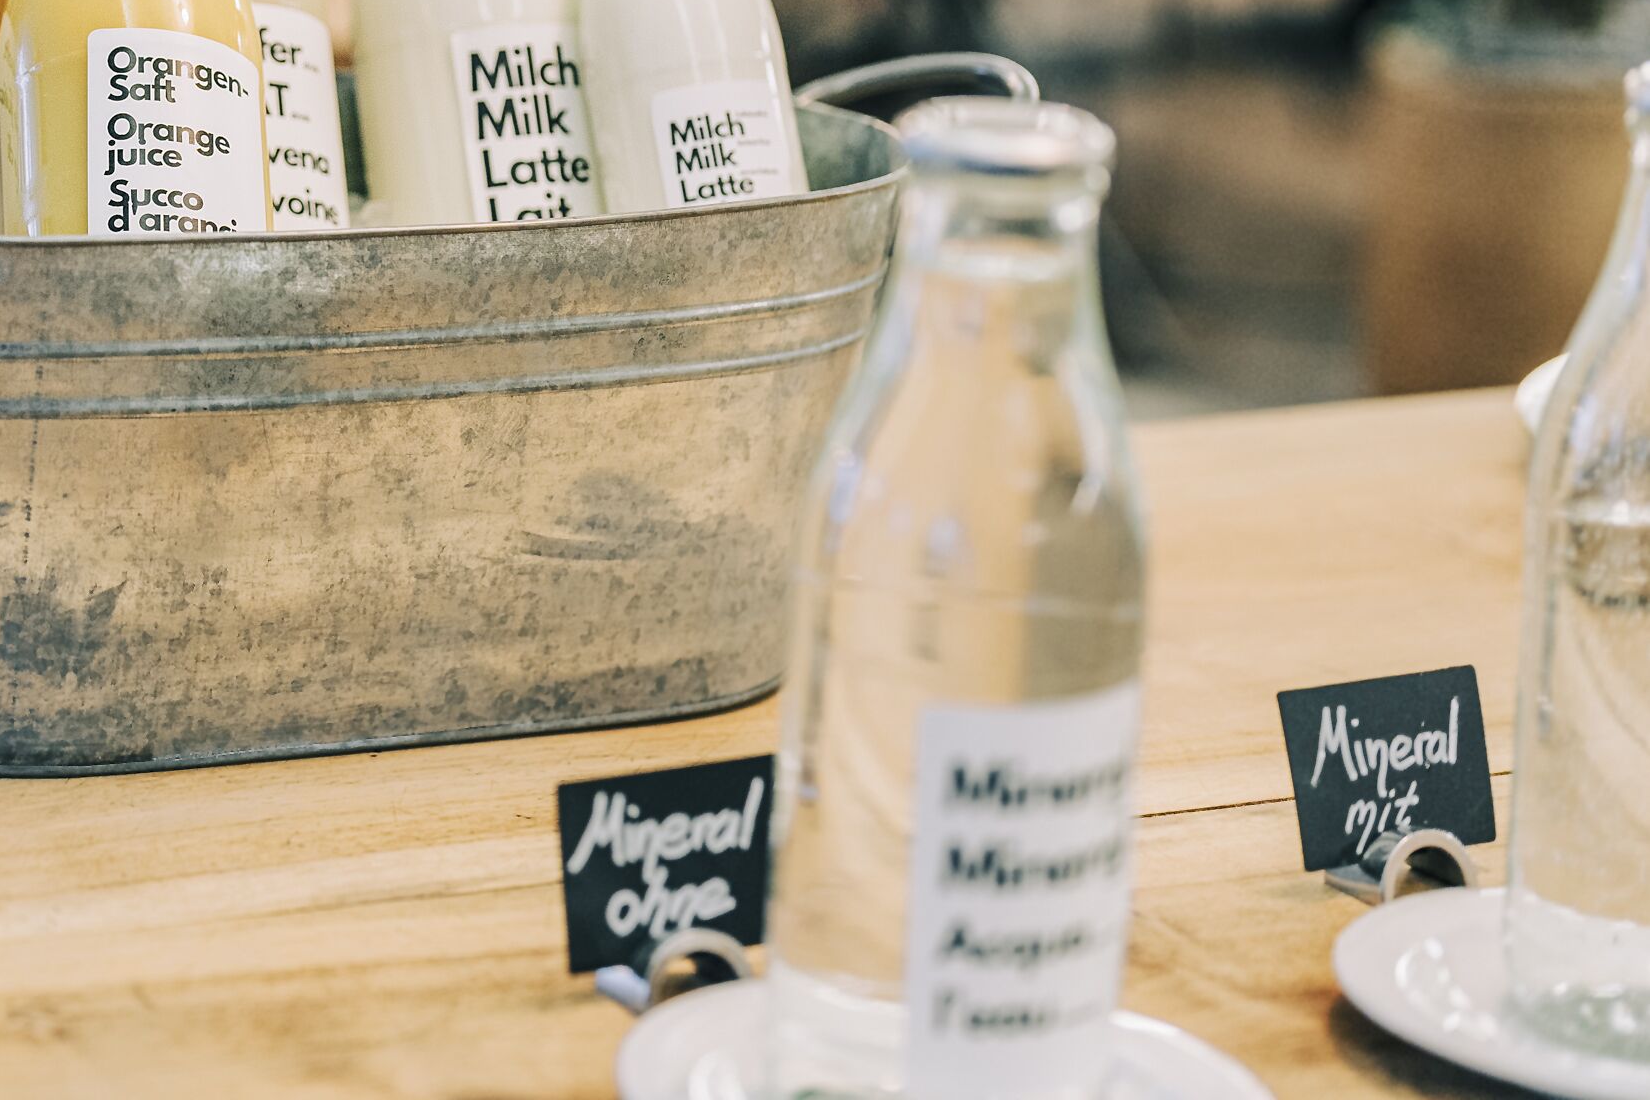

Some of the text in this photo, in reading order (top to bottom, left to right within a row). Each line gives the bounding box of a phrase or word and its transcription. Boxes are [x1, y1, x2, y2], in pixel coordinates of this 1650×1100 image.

[107, 46, 249, 97] Orangen-
[107, 74, 176, 103] Saft
[470, 45, 581, 92] Milch
[107, 113, 230, 156] Orange
[477, 94, 569, 140] Milk
[670, 112, 745, 146] Milch
[104, 140, 182, 175] juice
[482, 149, 590, 188] Latte
[676, 143, 737, 174] Milk
[108, 179, 203, 210] Succo
[681, 175, 754, 203] Latte
[1310, 696, 1459, 797] Mineral
[567, 776, 765, 885] Mineral
[1344, 781, 1420, 855] mit
[605, 865, 737, 937] ohne
